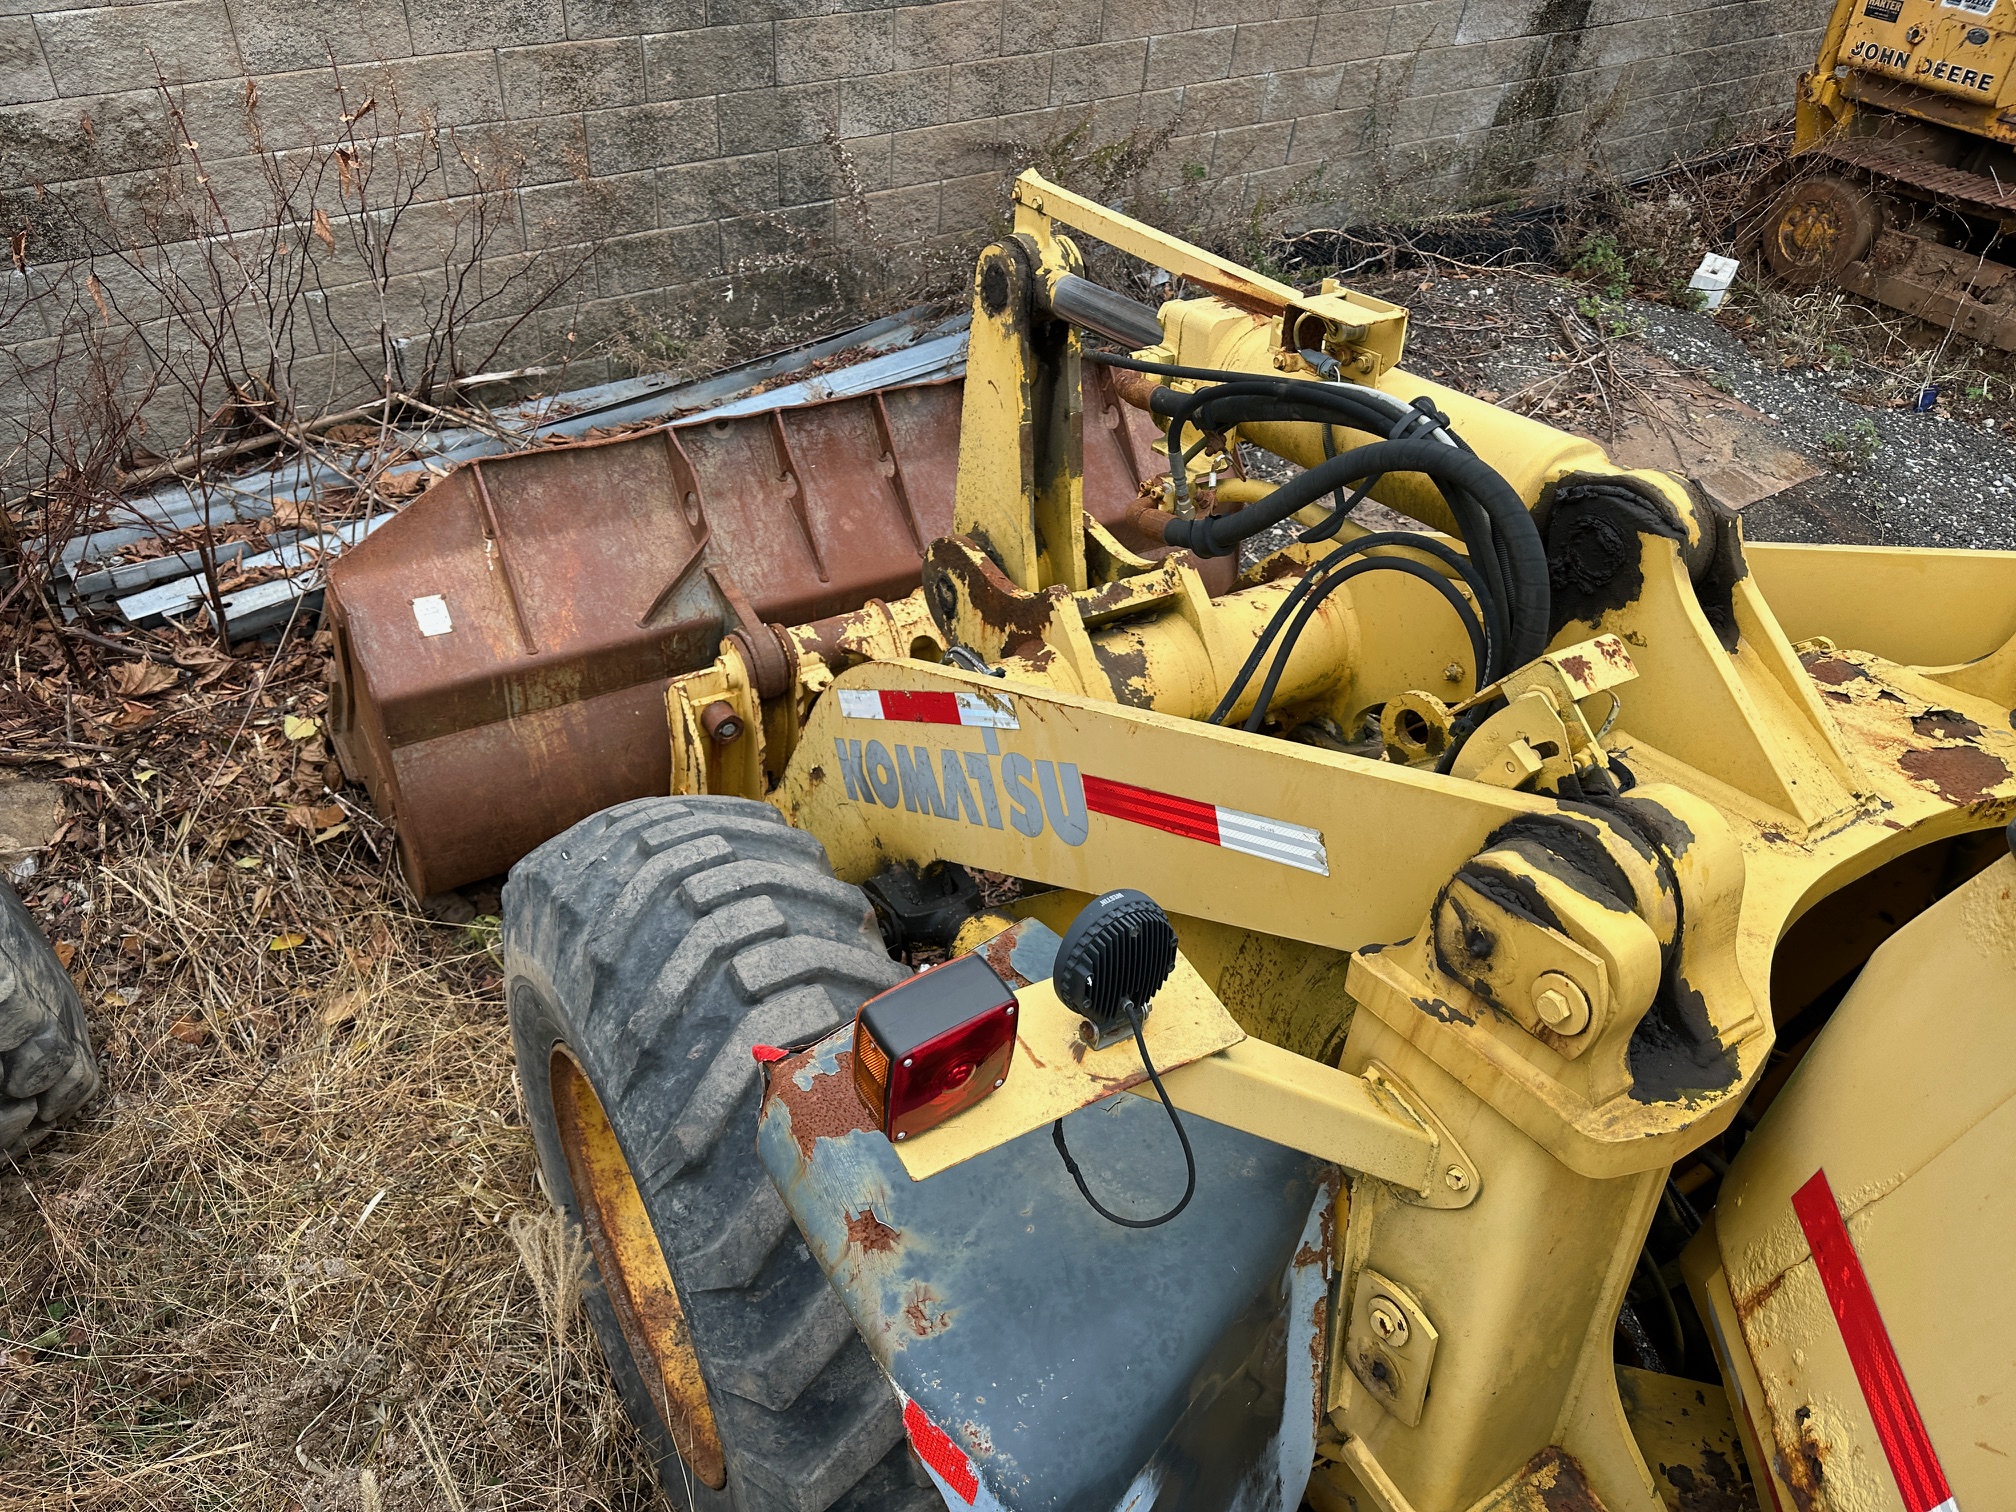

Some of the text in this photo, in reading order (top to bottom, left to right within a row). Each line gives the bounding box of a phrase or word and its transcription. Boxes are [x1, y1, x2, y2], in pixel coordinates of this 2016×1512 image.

[1850, 40, 1995, 93] JOHN DEERE
[834, 727, 1090, 847] KOMATSU
